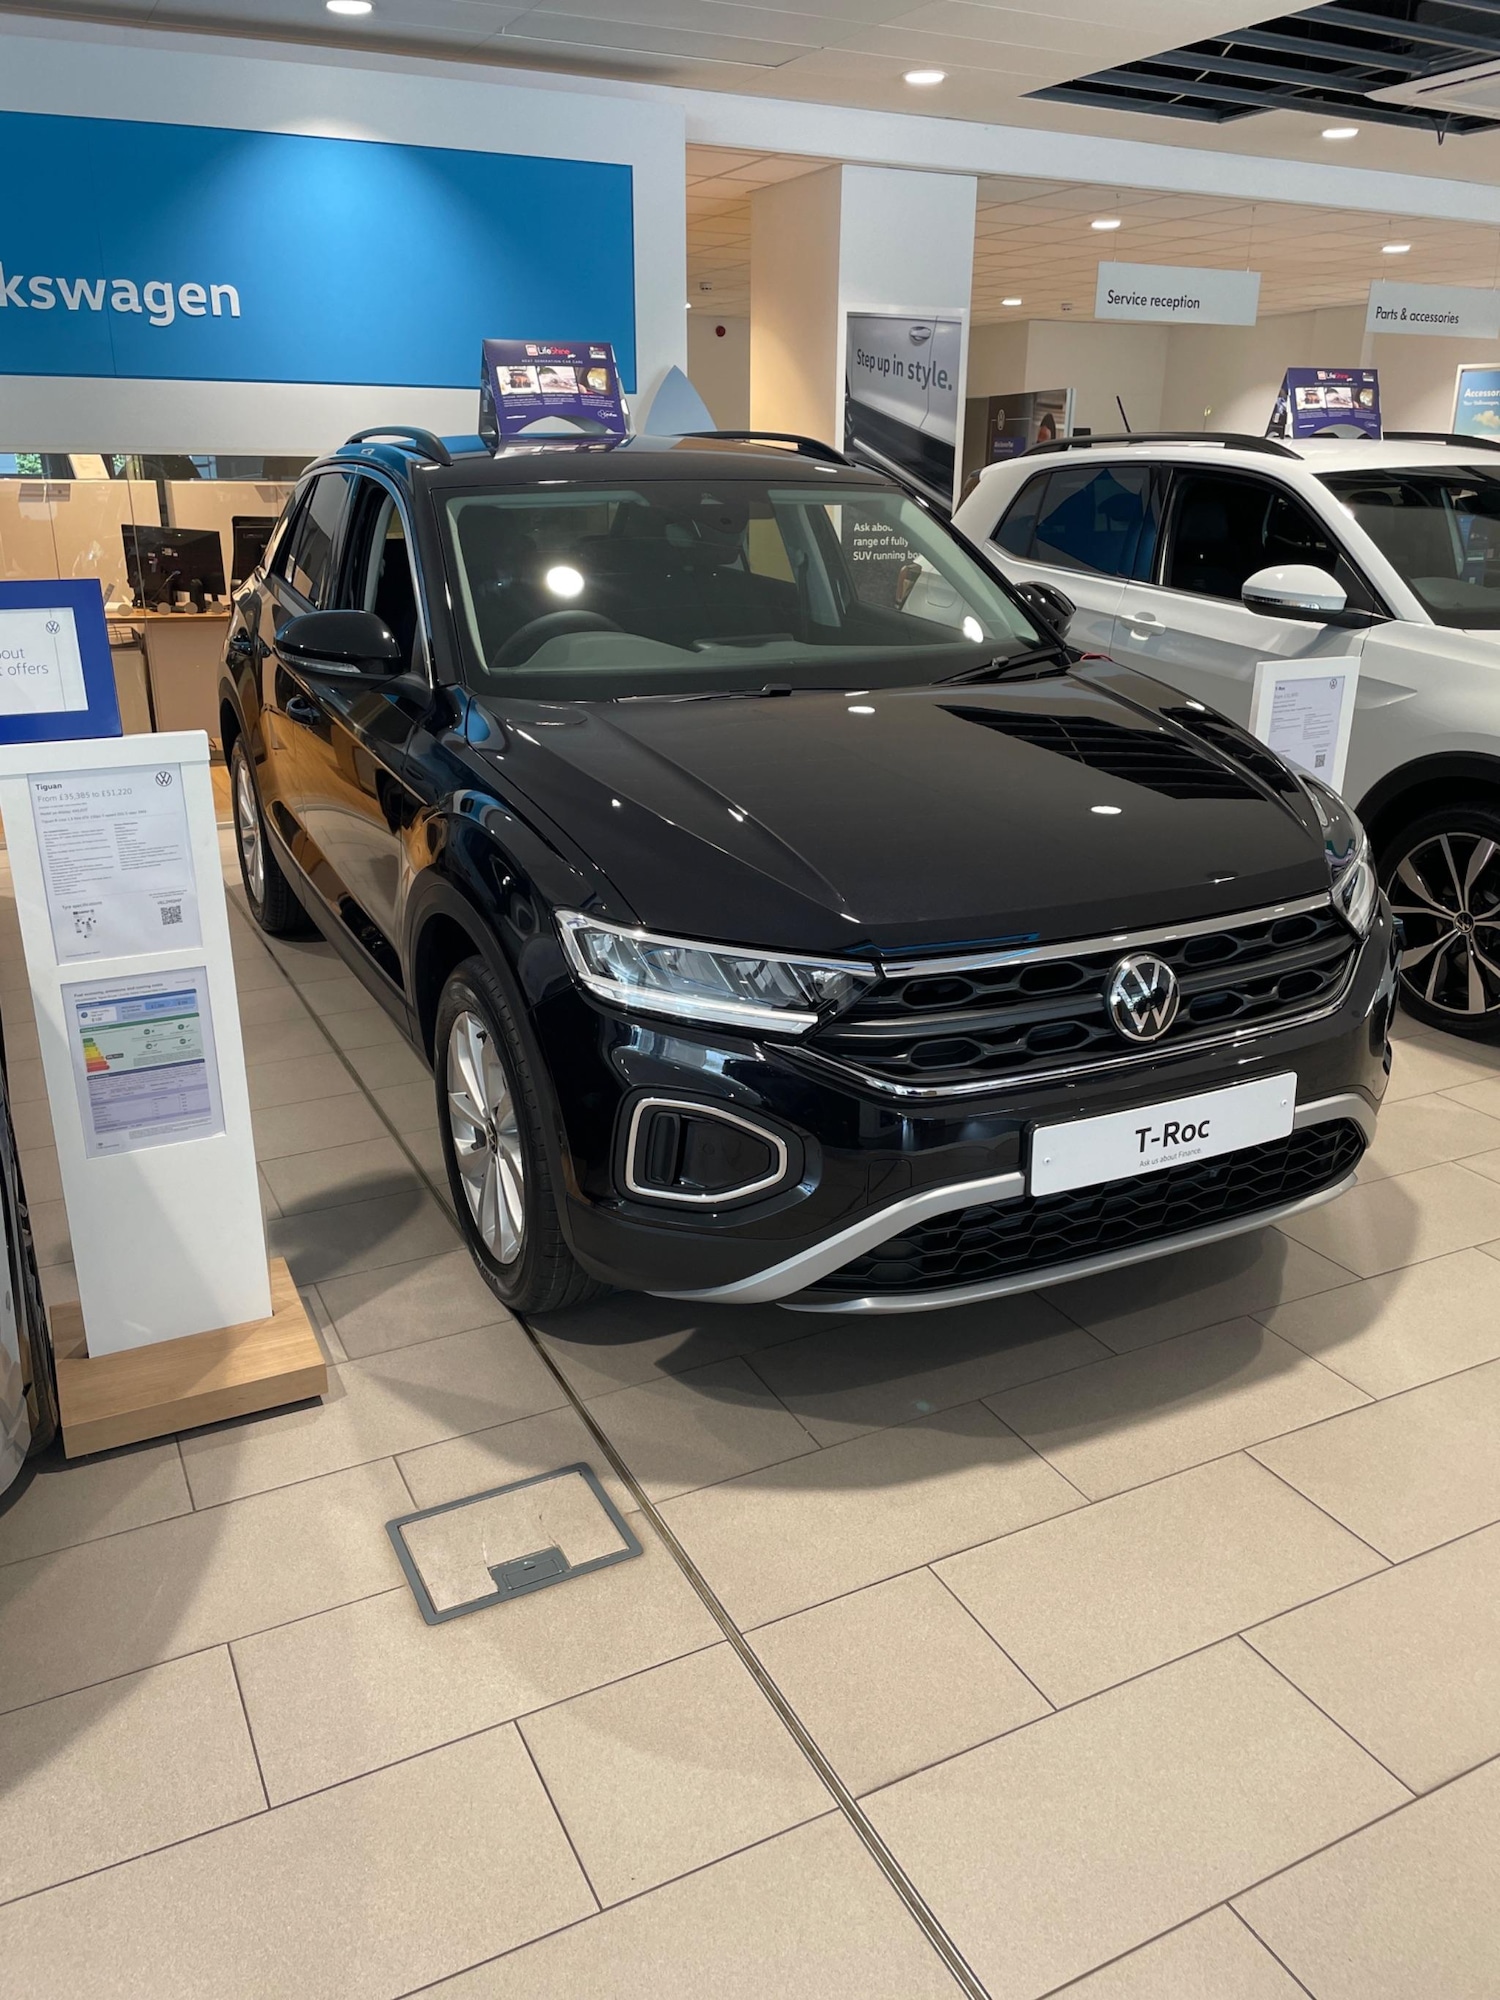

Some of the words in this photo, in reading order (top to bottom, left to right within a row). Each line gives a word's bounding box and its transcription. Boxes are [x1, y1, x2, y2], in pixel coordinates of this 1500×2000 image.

[1107, 289, 1148, 306] Service
[1150, 294, 1200, 311] reception
[1375, 306, 1398, 320] Parts
[1400, 307, 1407, 321] &
[1409, 311, 1459, 324] accessories
[856, 348, 876, 373] Step
[877, 356, 890, 377] up
[893, 353, 904, 377] in
[907, 360, 953, 391] style.
[854, 523, 870, 532] Ask
[854, 539, 878, 548] range
[880, 537, 889, 546] of
[891, 537, 909, 548] fully
[853, 551, 872, 561] SUV
[873, 551, 906, 562] running
[907, 551, 920, 560] bo
[0, 648, 26, 660] out
[7, 662, 49, 676] offers
[35, 783, 63, 792] Tiguan
[59, 791, 90, 801] £35,385
[102, 787, 133, 797] £51,220
[1135, 1120, 1210, 1153] T-Roc
[1139, 1159, 1150, 1167] Ask
[1160, 1153, 1177, 1163] about
